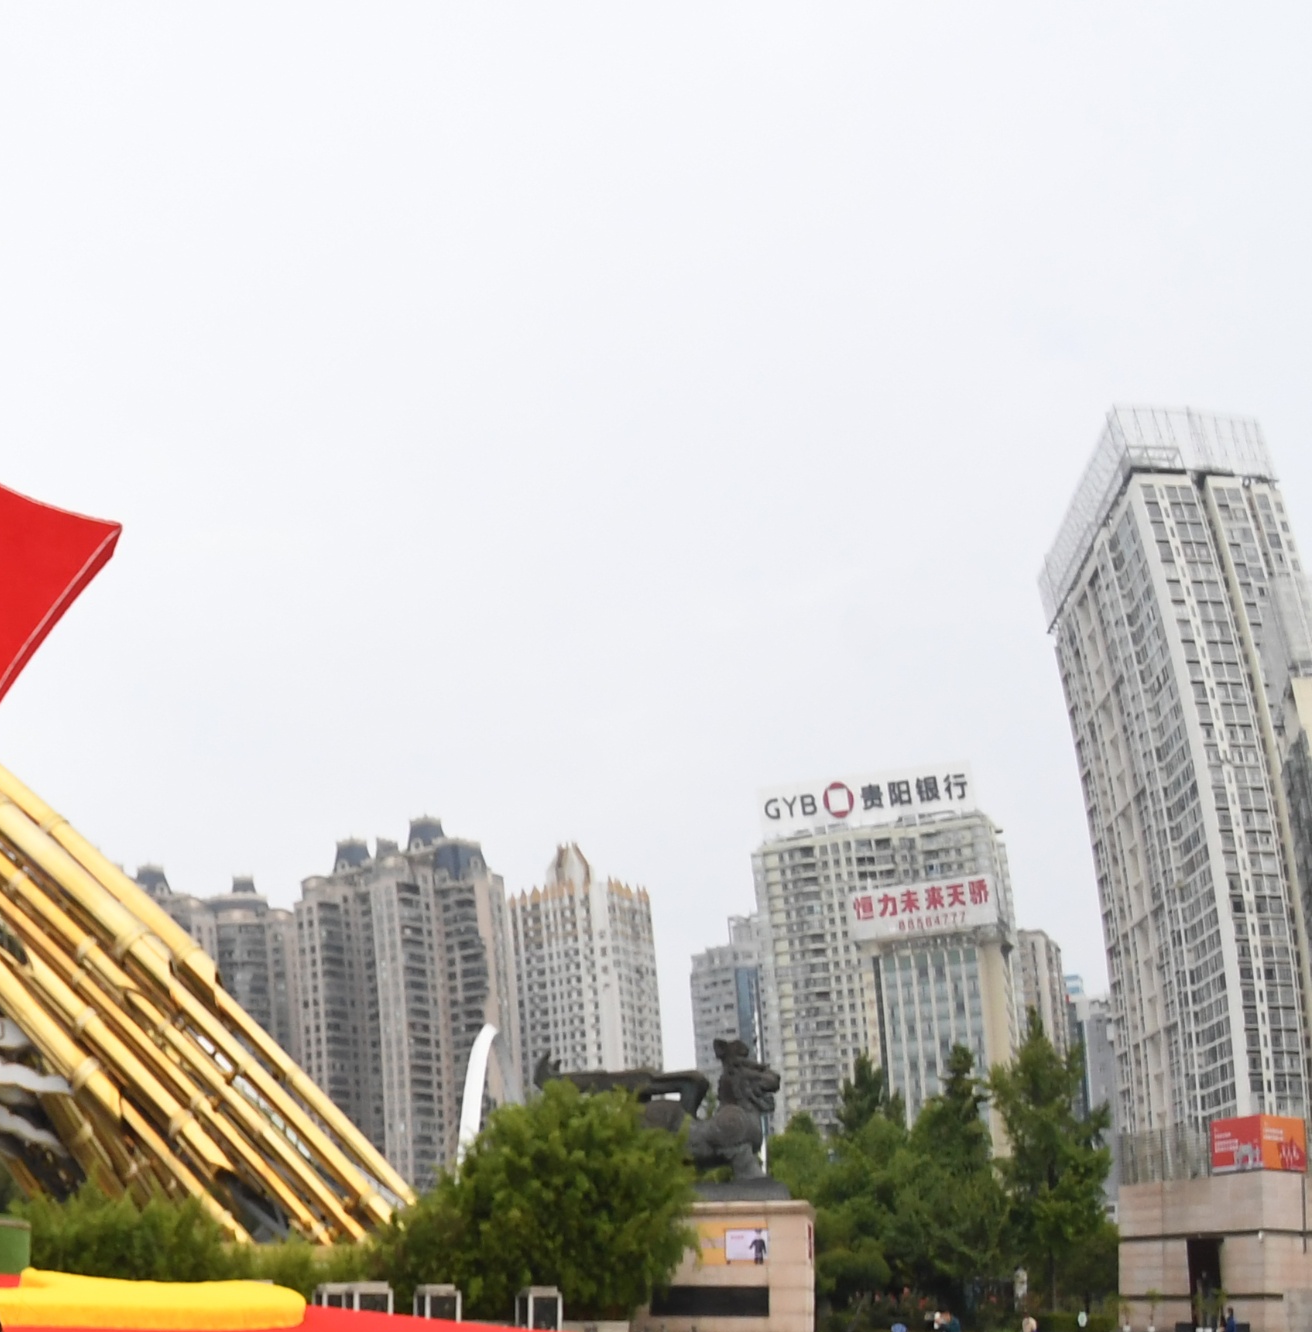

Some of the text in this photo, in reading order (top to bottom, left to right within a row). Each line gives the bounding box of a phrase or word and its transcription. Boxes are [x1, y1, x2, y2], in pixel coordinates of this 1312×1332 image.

[764, 794, 818, 820] GYB
[861, 773, 968, 810] 贵阳银行
[853, 879, 989, 921] 恒力未来天骄
